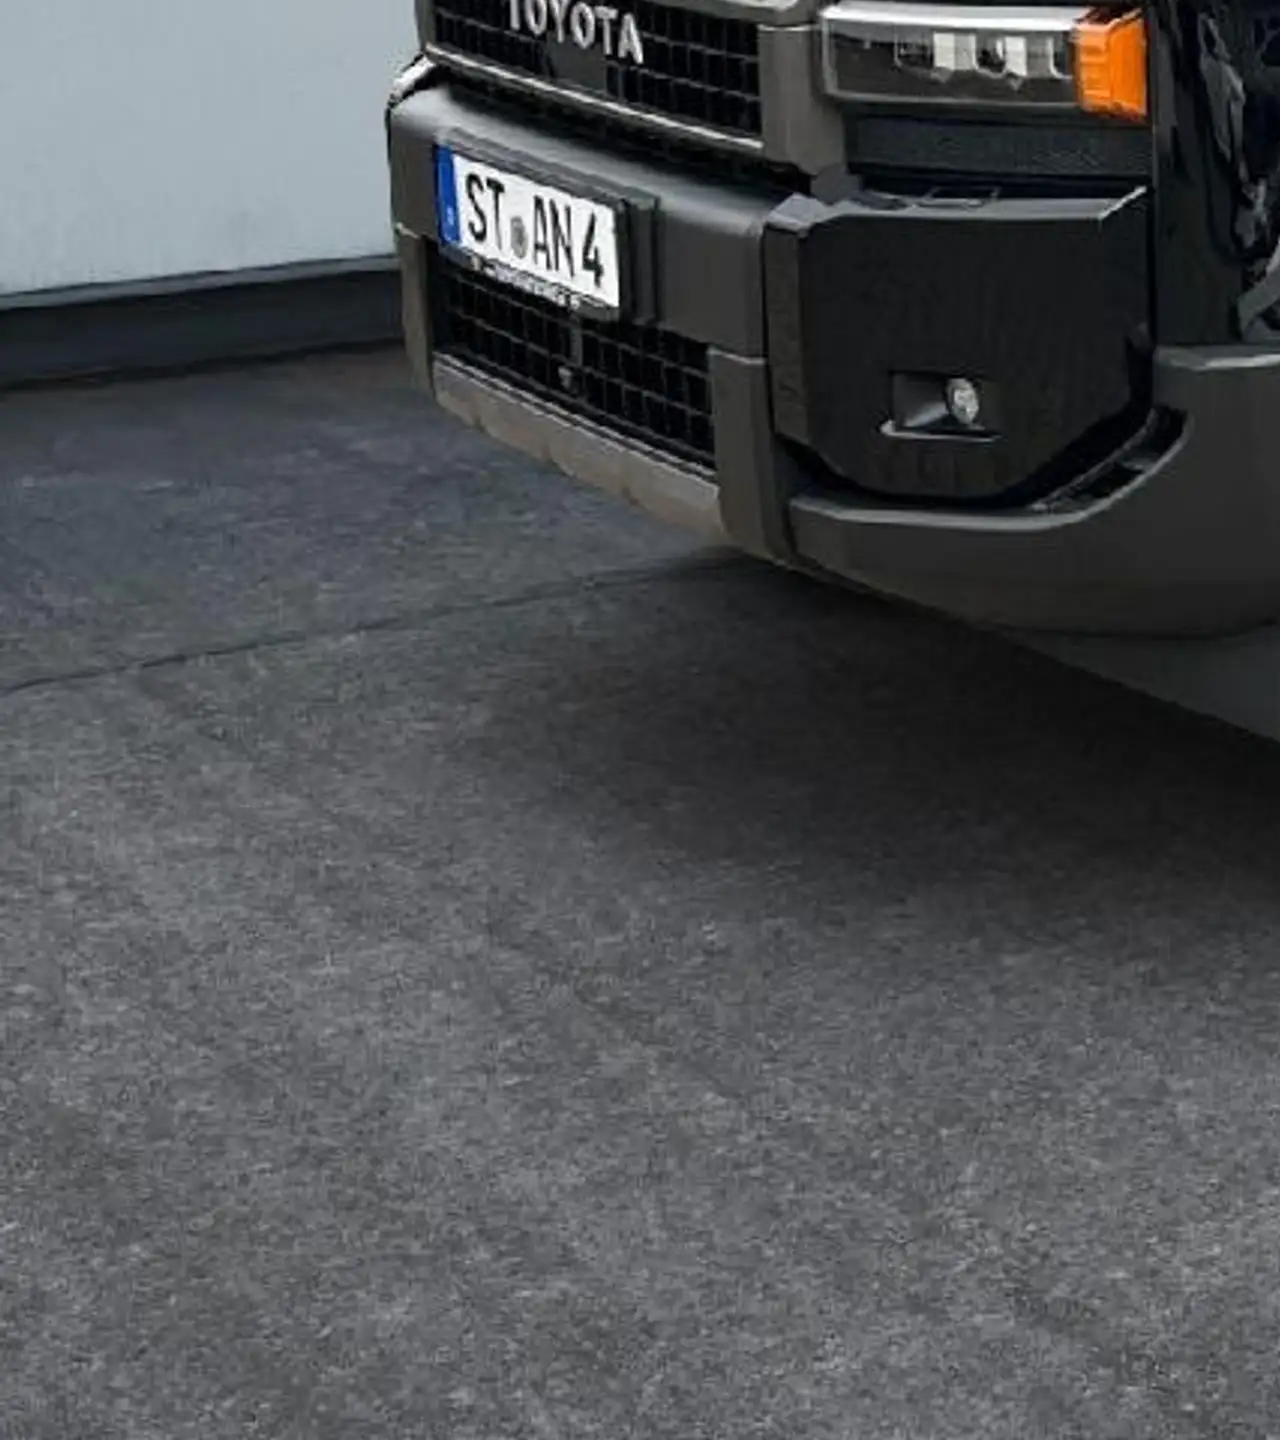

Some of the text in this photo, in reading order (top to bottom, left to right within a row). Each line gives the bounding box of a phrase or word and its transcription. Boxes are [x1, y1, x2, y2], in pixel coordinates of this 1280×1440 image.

[465, 172, 506, 254] ST
[532, 194, 575, 279] AN
[581, 211, 604, 288] 4
